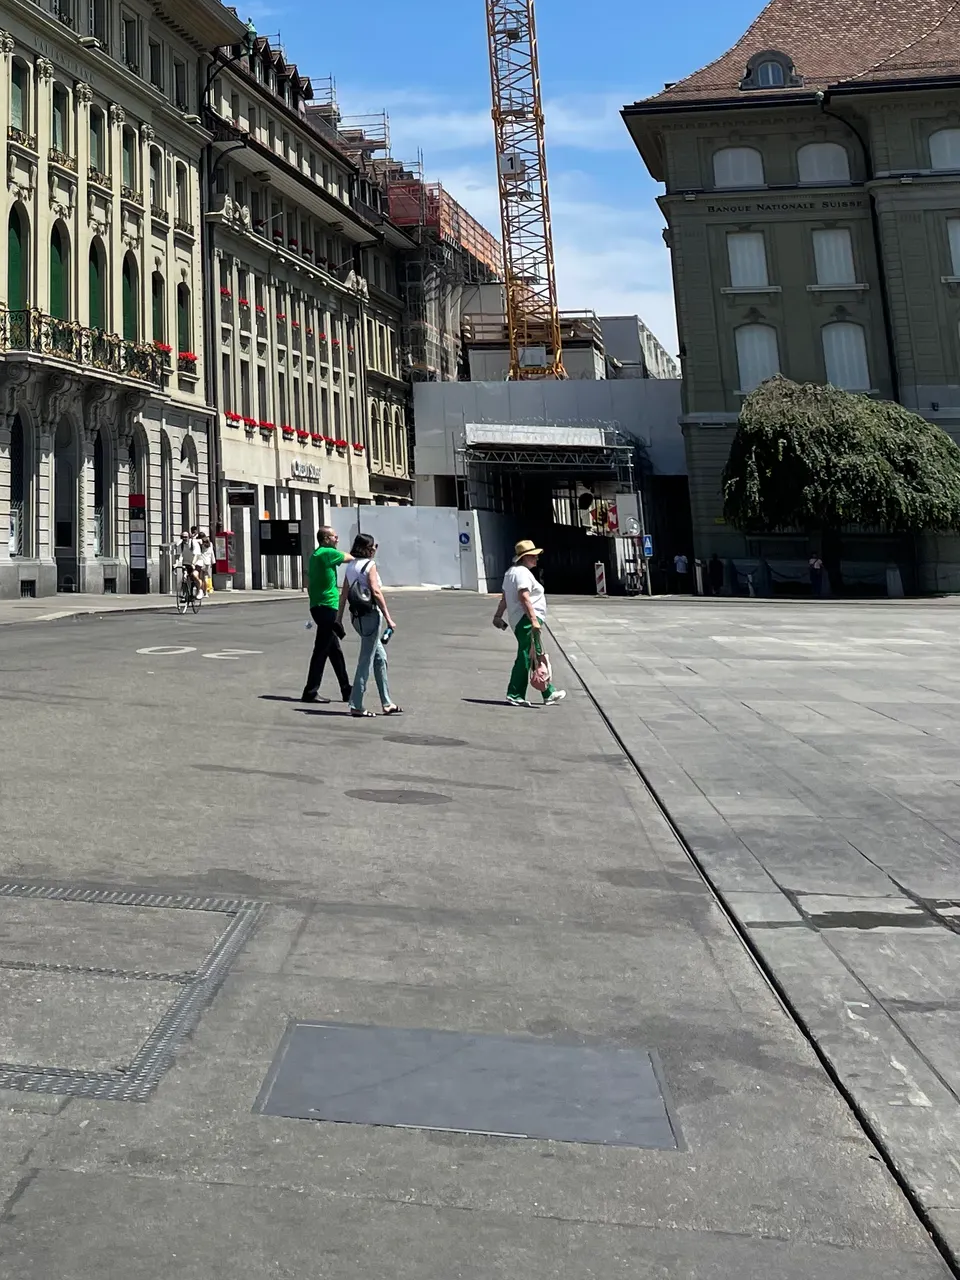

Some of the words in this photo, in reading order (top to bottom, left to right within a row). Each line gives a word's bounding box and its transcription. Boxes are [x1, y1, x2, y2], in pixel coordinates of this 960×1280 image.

[507, 157, 514, 170] 1
[707, 205, 751, 213] BANQUE
[756, 202, 815, 211] NATIONALE
